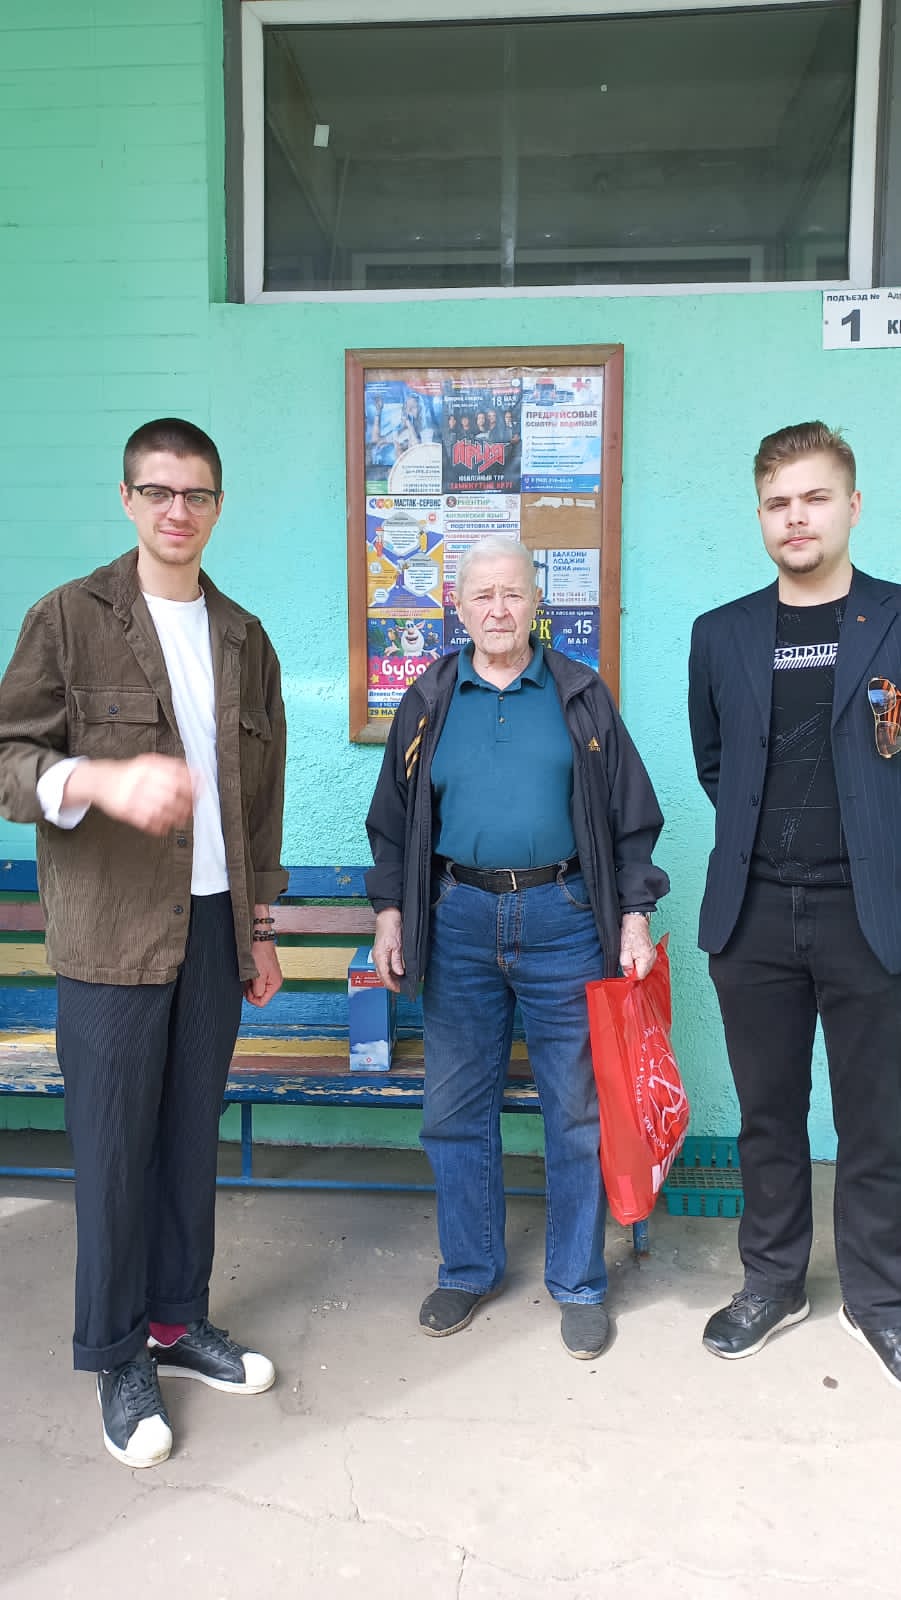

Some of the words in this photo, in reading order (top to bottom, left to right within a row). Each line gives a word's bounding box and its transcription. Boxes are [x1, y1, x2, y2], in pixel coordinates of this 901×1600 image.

[826, 294, 868, 302] ПОДЪЕЗД
[841, 308, 861, 342] 1
[574, 619, 593, 635] 15
[567, 637, 589, 645] МАЯ
